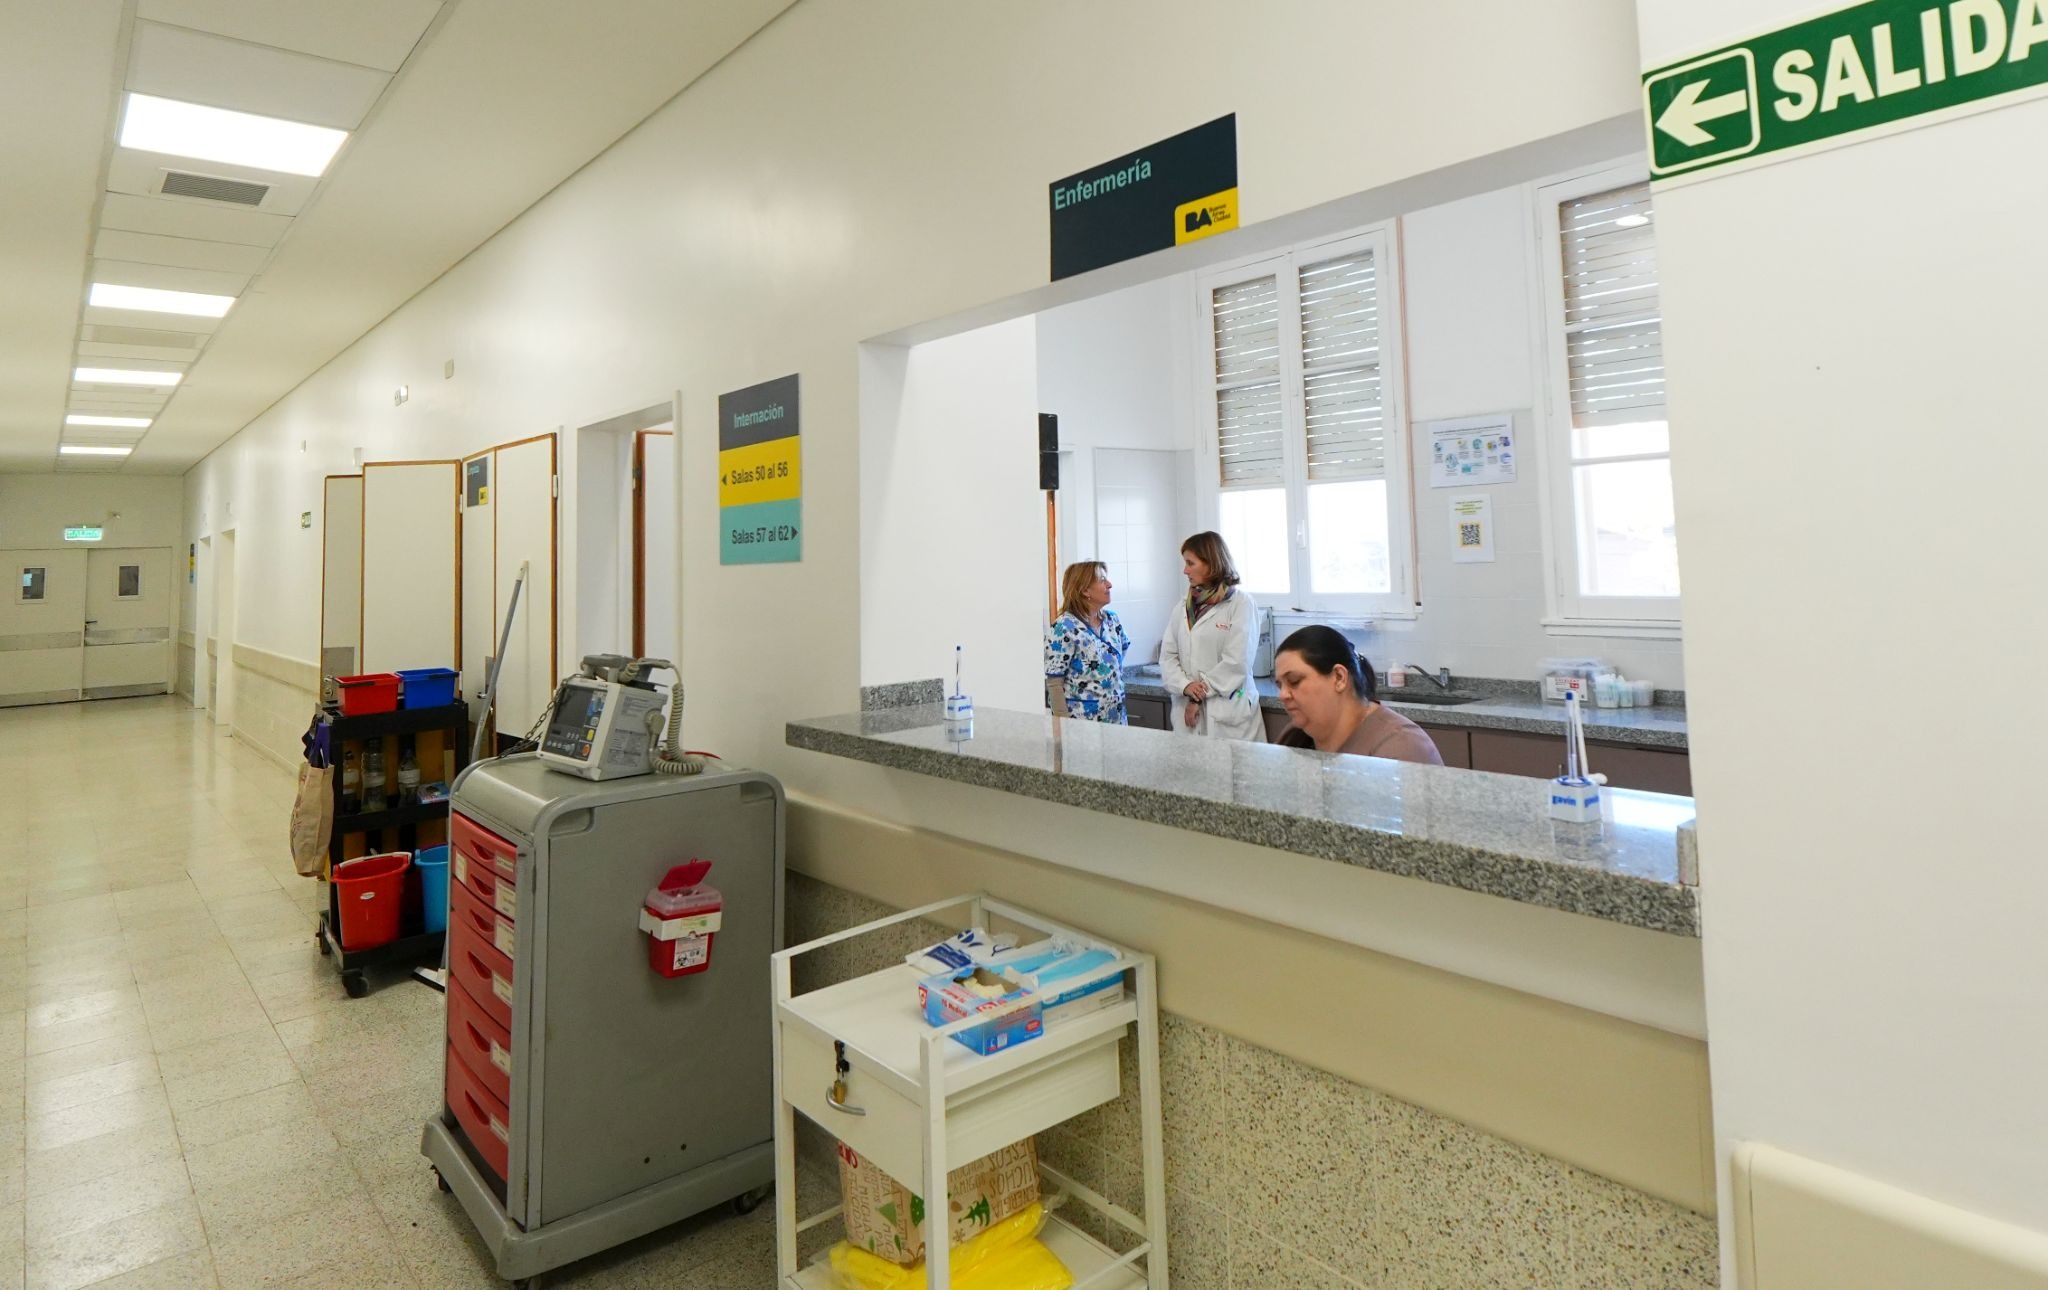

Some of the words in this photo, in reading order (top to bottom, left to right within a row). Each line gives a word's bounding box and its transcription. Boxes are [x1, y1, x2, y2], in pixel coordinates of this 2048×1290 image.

[1772, 0, 2048, 122] SALIDA
[1054, 158, 1152, 211] Enfermería
[1185, 208, 1212, 233] BA
[733, 403, 785, 429] Internación
[731, 469, 753, 485] Salas
[755, 465, 766, 481] 50
[768, 463, 776, 479] al
[777, 461, 789, 478] 56
[731, 528, 755, 545] Salas
[756, 527, 766, 543] 57
[768, 526, 776, 542] al
[778, 525, 789, 541] 62
